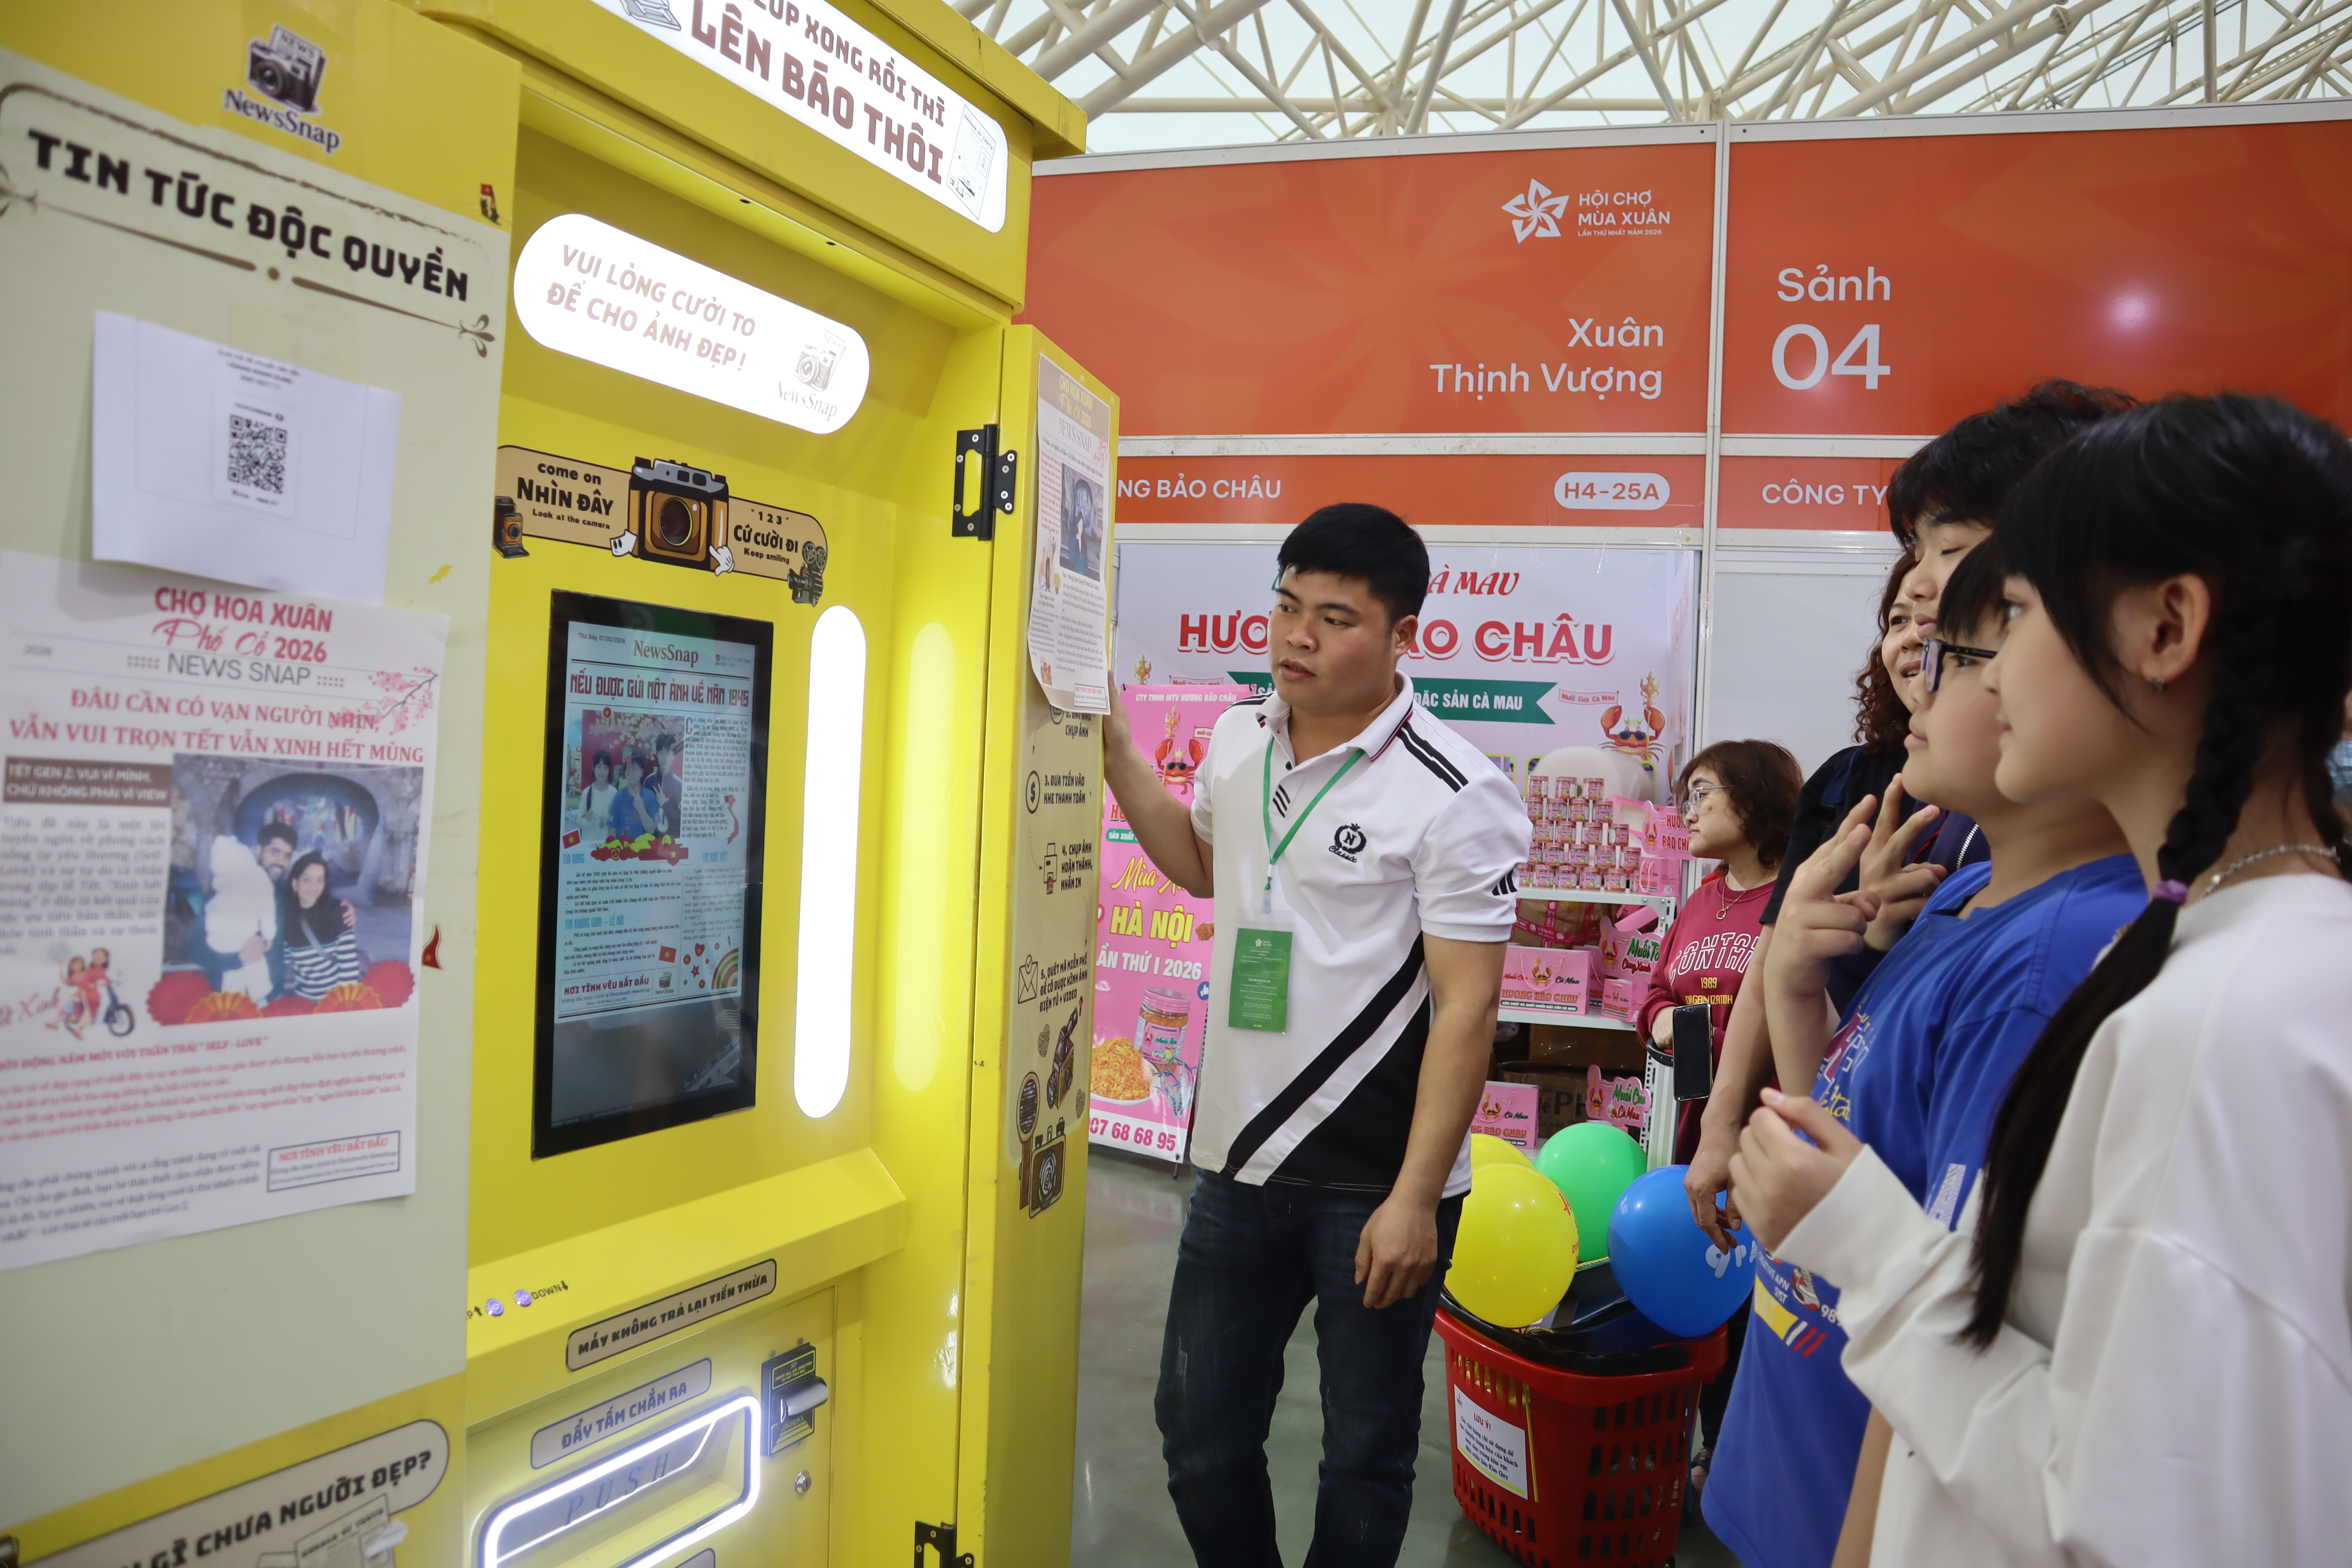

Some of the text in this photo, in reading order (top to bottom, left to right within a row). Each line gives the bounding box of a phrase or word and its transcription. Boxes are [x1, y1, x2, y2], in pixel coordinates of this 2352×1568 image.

[805, 14, 862, 74] XONG
[868, 56, 906, 102] RỒI
[691, 0, 771, 81] LÊN
[864, 102, 943, 185] THÔI
[223, 89, 339, 154] NewsSnap
[1578, 189, 1652, 209] HỘI CHỢ
[28, 128, 129, 194] TIN
[247, 203, 332, 259] ĐỘC
[343, 235, 468, 302] QUYỀN
[1577, 208, 1671, 226] MÙA XUÂN
[564, 244, 755, 336] VUI LÒNG CƯỜI TO
[1777, 264, 1891, 302] Sảnh
[546, 280, 586, 313] ĐỂ
[587, 298, 638, 332] CHO
[642, 310, 693, 352] ẢNH
[1567, 316, 1664, 347] Xuân
[1771, 323, 1891, 390] 04
[1429, 363, 1662, 401] Thịnh Vượng
[774, 381, 838, 422] NewsSnap
[1081, 410, 1092, 429] 2026
[537, 463, 601, 485] come on
[1156, 472, 1207, 498] BẢO
[1212, 474, 1281, 499] CHÂU
[517, 476, 614, 516] NHÌN ĐÂY
[1564, 482, 1660, 500] H4-25A
[1762, 478, 1888, 505] CÔNG TY
[532, 508, 611, 530] Look at the camera
[733, 524, 799, 553] CỨ CƯỜI ĐI
[744, 547, 790, 565] Keep smiling
[1427, 563, 1520, 596] À MAU
[154, 587, 332, 632] CHỢ HOA XUÂN
[152, 618, 327, 663] Phố 2026
[599, 634, 626, 644] 07/02/2026
[1474, 613, 1613, 664] CHÂU
[633, 639, 699, 668] NewsSnap
[168, 653, 311, 686] NEWS SNAP
[570, 667, 592, 694] NẾU
[595, 675, 624, 700] ĐƯỢC
[647, 677, 667, 703] MỘT
[669, 678, 688, 702] ẢNH
[691, 679, 704, 703] VỀ
[706, 683, 725, 705] NĂM
[1165, 693, 1180, 702] MTV
[1180, 693, 1203, 702] HƯƠNG
[1204, 692, 1218, 702] BẢO
[1218, 692, 1237, 702] CHÂU
[1414, 689, 1523, 710] ĐẶC SẢN CÀ MAU
[176, 695, 205, 717] CÓ
[211, 701, 250, 723] VẠN
[255, 704, 322, 727] NGƯỜI
[66, 722, 107, 744] VUI
[114, 727, 177, 751] TRỌN
[181, 727, 225, 751] TẾT
[273, 737, 322, 757] XINH
[326, 738, 365, 759] HẾT
[1065, 722, 1089, 740] CHỤP ẢNH
[1044, 774, 1061, 787] 3. ĐƯA
[1044, 789, 1085, 804] KHE THANH TOÁN
[1062, 839, 1092, 858] 4. CHỤP ẢNH
[1108, 828, 1134, 841] SẢN XUẤT
[1343, 831, 1357, 846] N
[1075, 877, 1082, 888] IN
[1110, 855, 1159, 893] Mùa
[1109, 900, 1194, 949] HÀ NỘI
[1041, 952, 1087, 980] 5. PHÍ
[1078, 968, 1088, 981] ẢNH
[1095, 942, 1202, 981] ẦN THỨ 2026
[564, 980, 617, 995] NƠI YÊU
[1700, 977, 1717, 989] 1989
[1039, 988, 1077, 1013] ĐIỆN VIDEO
[1089, 1117, 1176, 1152] 07 68 68 95
[530, 1283, 563, 1300] DOWN
[578, 1274, 768, 1356] MÁY KHÔNG TRẢ LẠI TIỀN THỪA
[561, 1381, 688, 1450] ĐẨY TẤM CHẮN RA
[1474, 1412, 1484, 1426] LƯU
[372, 1450, 432, 1489] ĐẸP?
[1490, 1456, 1499, 1466] khu
[1494, 1452, 1518, 1468] của khách
[563, 1451, 671, 1528] PUSH
[196, 1510, 272, 1557] CHƯA
